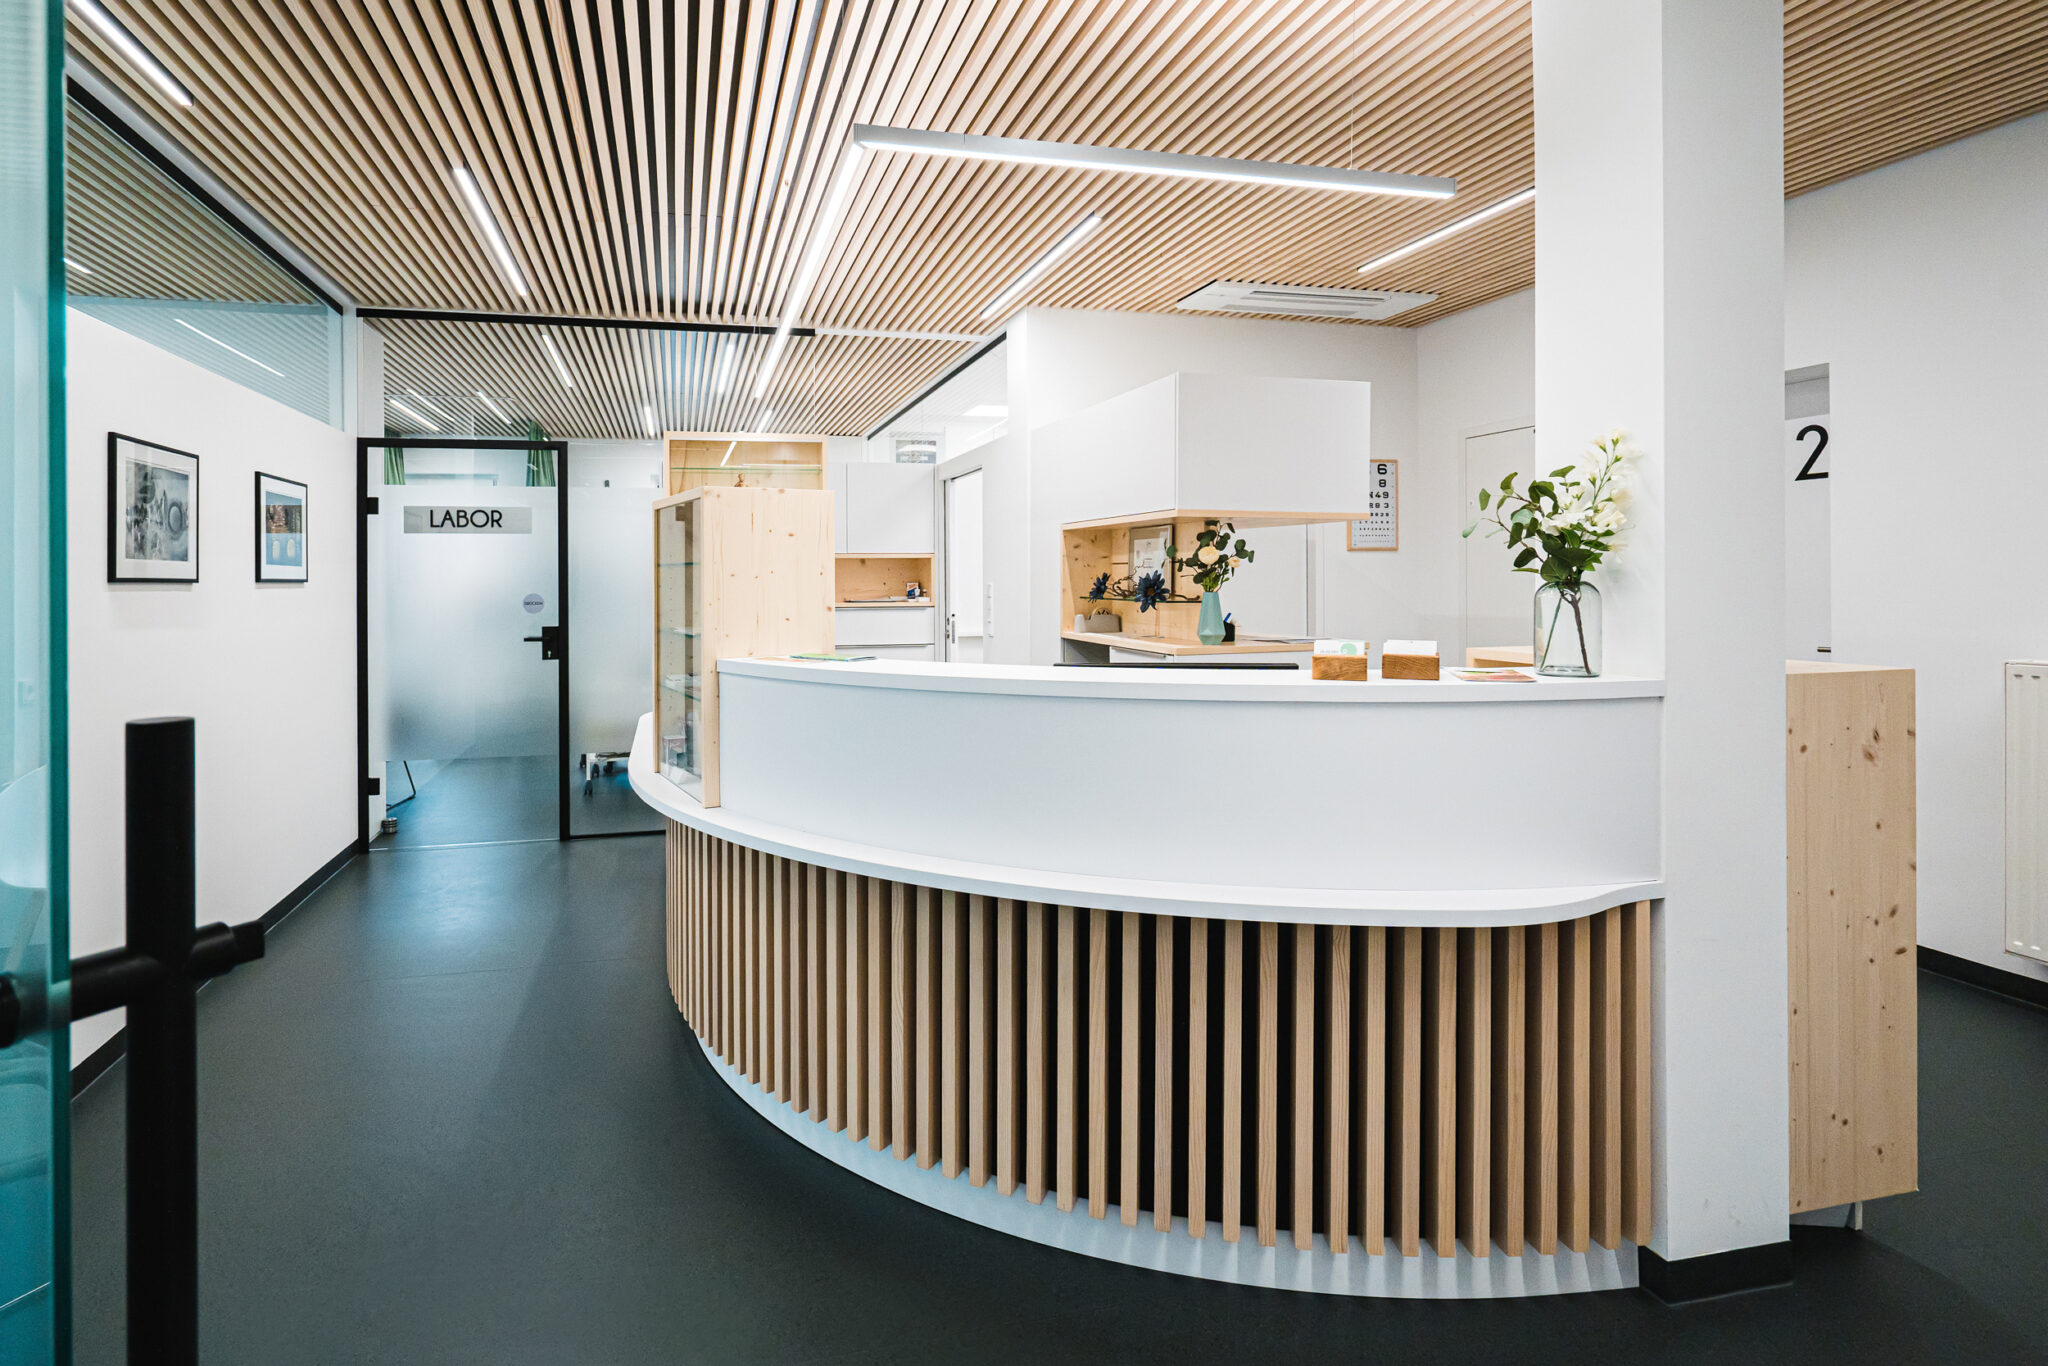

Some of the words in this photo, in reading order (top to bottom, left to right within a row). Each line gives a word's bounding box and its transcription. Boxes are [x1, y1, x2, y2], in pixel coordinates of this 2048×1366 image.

[1794, 424, 1829, 481] 2
[1377, 463, 1387, 475] 6
[1378, 479, 1387, 488] 8
[430, 509, 503, 528] LABOR
